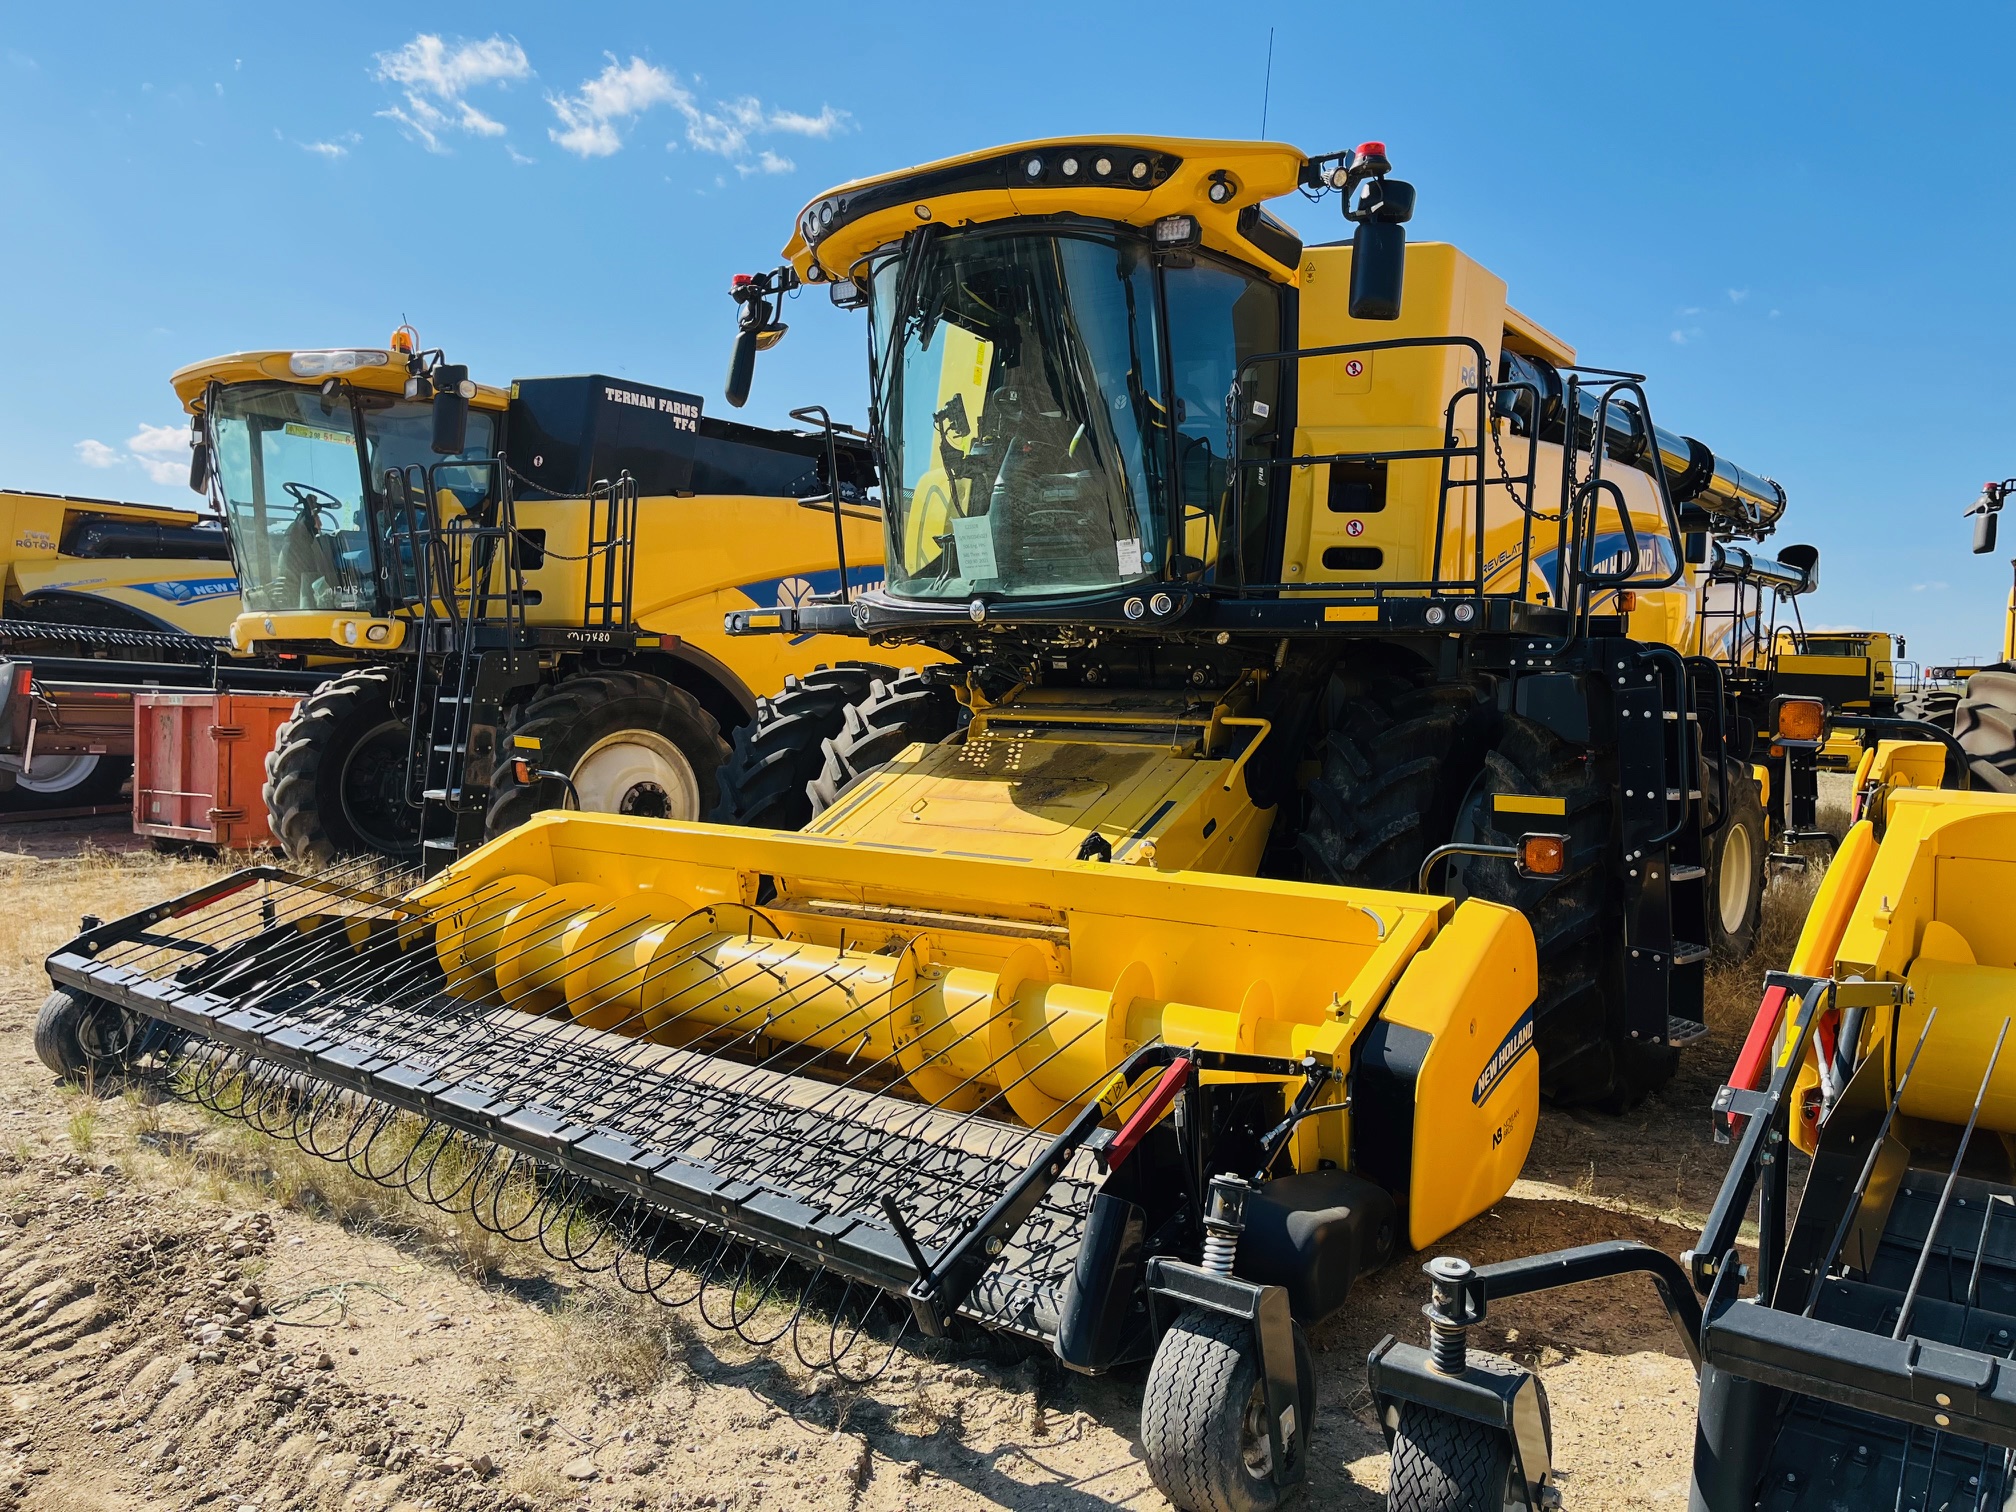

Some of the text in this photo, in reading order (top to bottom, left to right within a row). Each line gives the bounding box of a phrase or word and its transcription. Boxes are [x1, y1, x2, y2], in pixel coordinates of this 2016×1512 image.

[605, 387, 699, 419] TERNAN FARMS
[673, 416, 697, 433] TF4
[23, 529, 50, 541] TWIN
[15, 538, 56, 551] ROTOR
[193, 583, 228, 595] NEW
[1478, 1020, 1534, 1096] NEW HOLLAND
